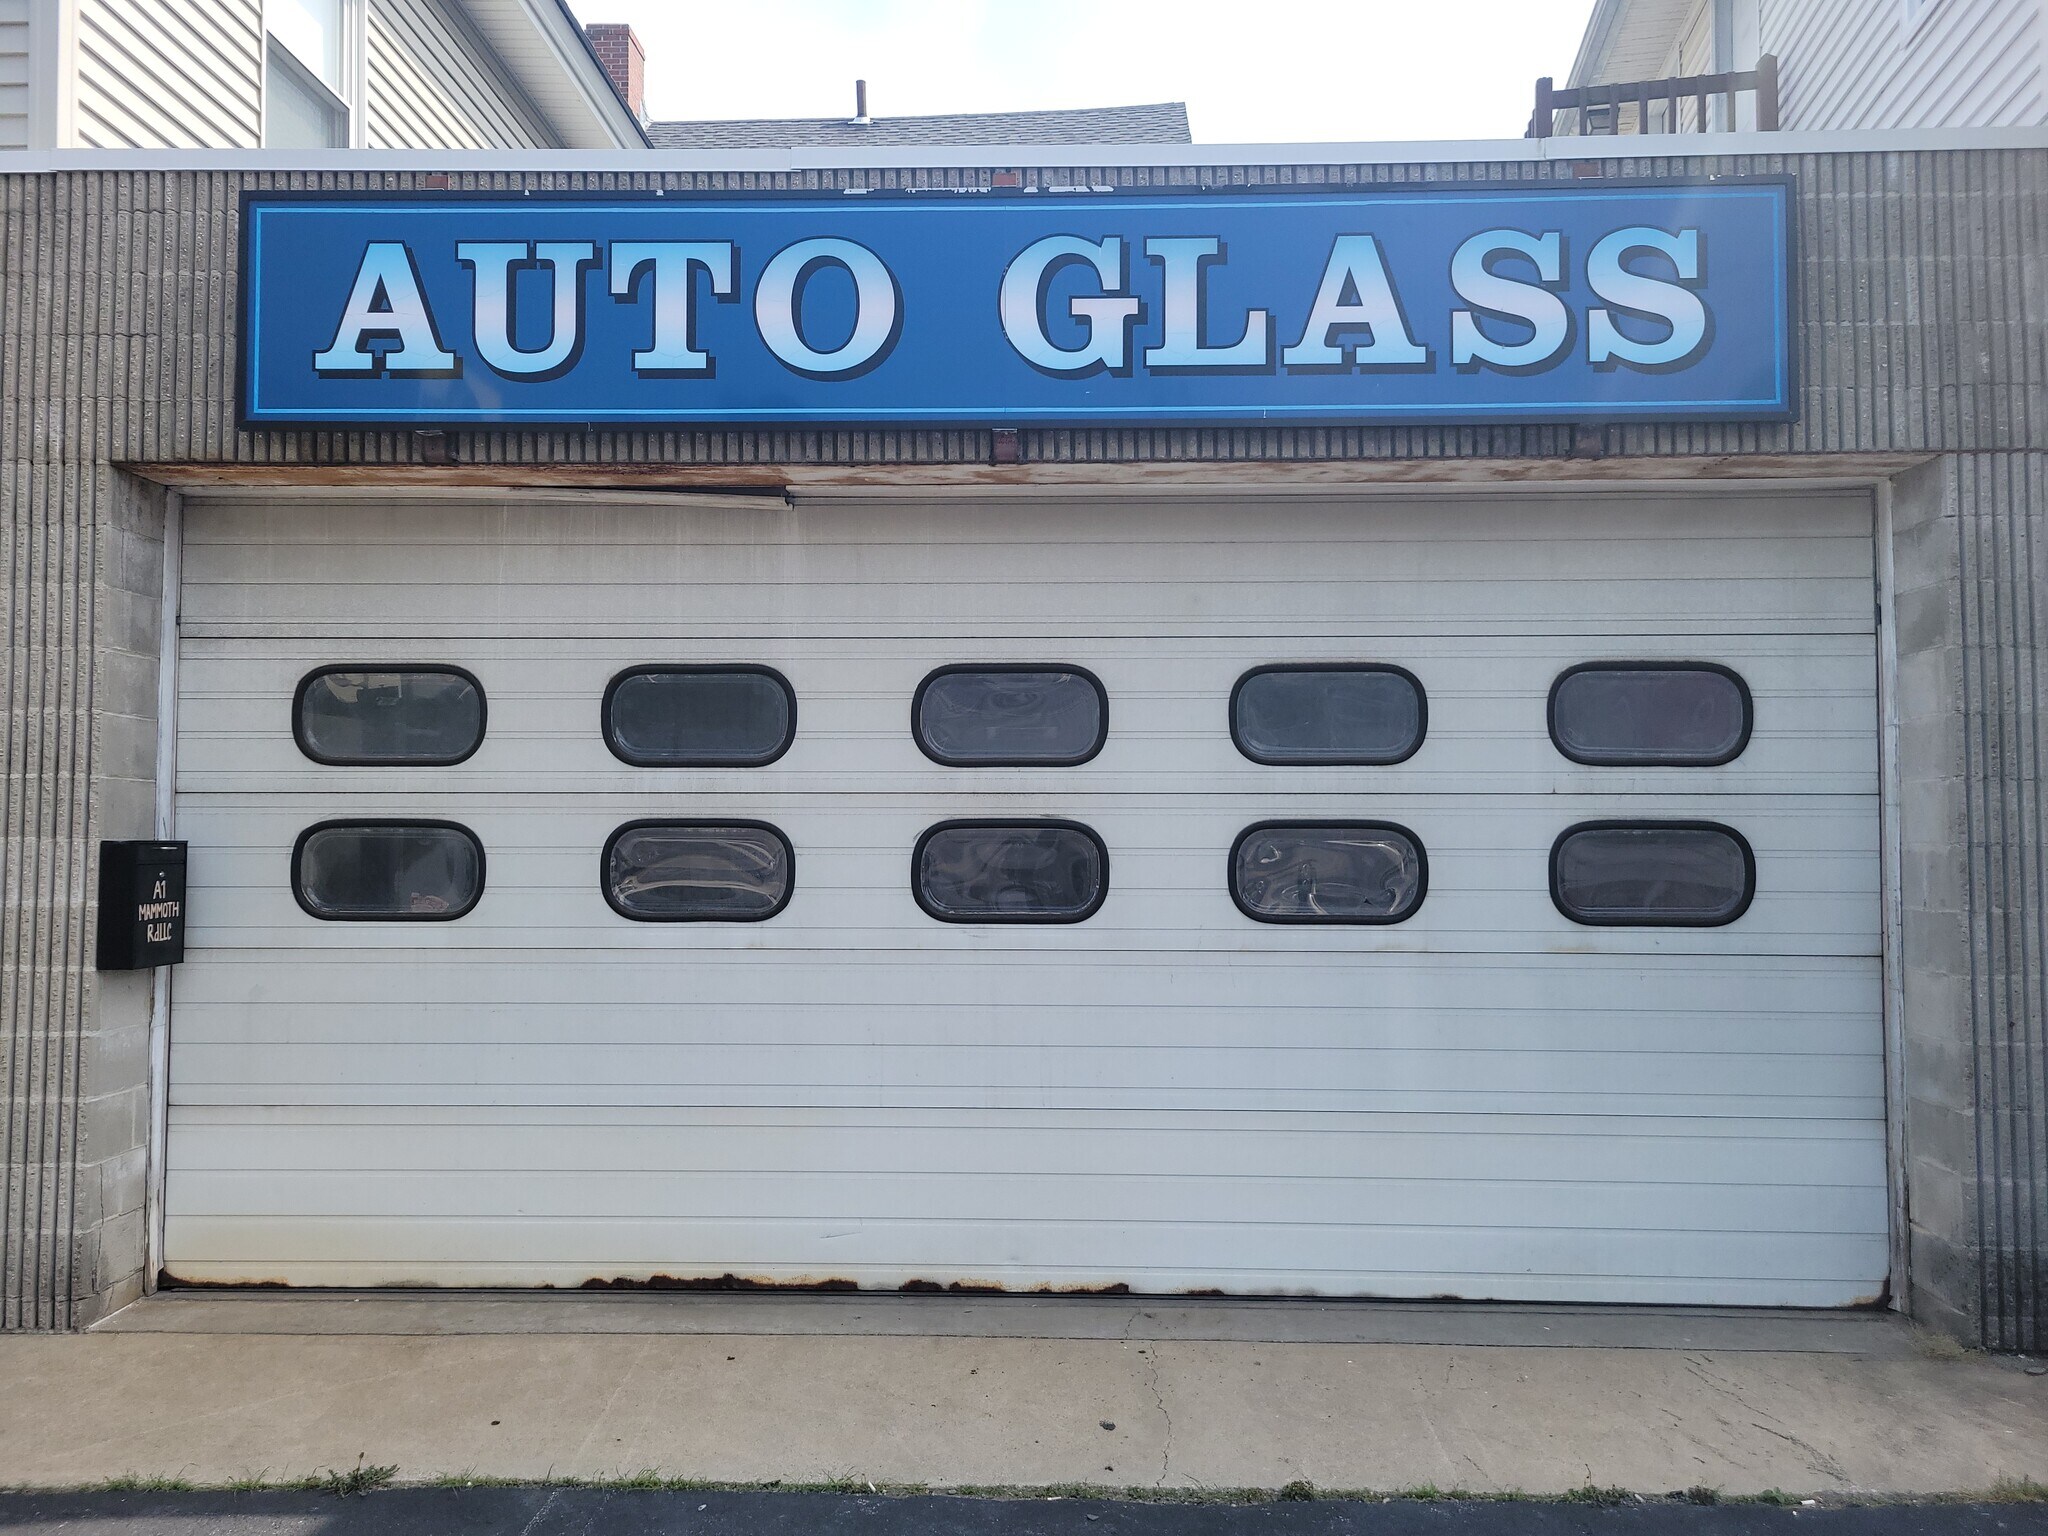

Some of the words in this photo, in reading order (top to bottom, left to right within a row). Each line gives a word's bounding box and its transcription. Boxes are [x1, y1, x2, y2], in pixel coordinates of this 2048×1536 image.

[312, 236, 900, 378] AUTO
[1000, 227, 1711, 373] GLASS
[152, 880, 167, 900] A1
[138, 901, 180, 921] MAMMOTH
